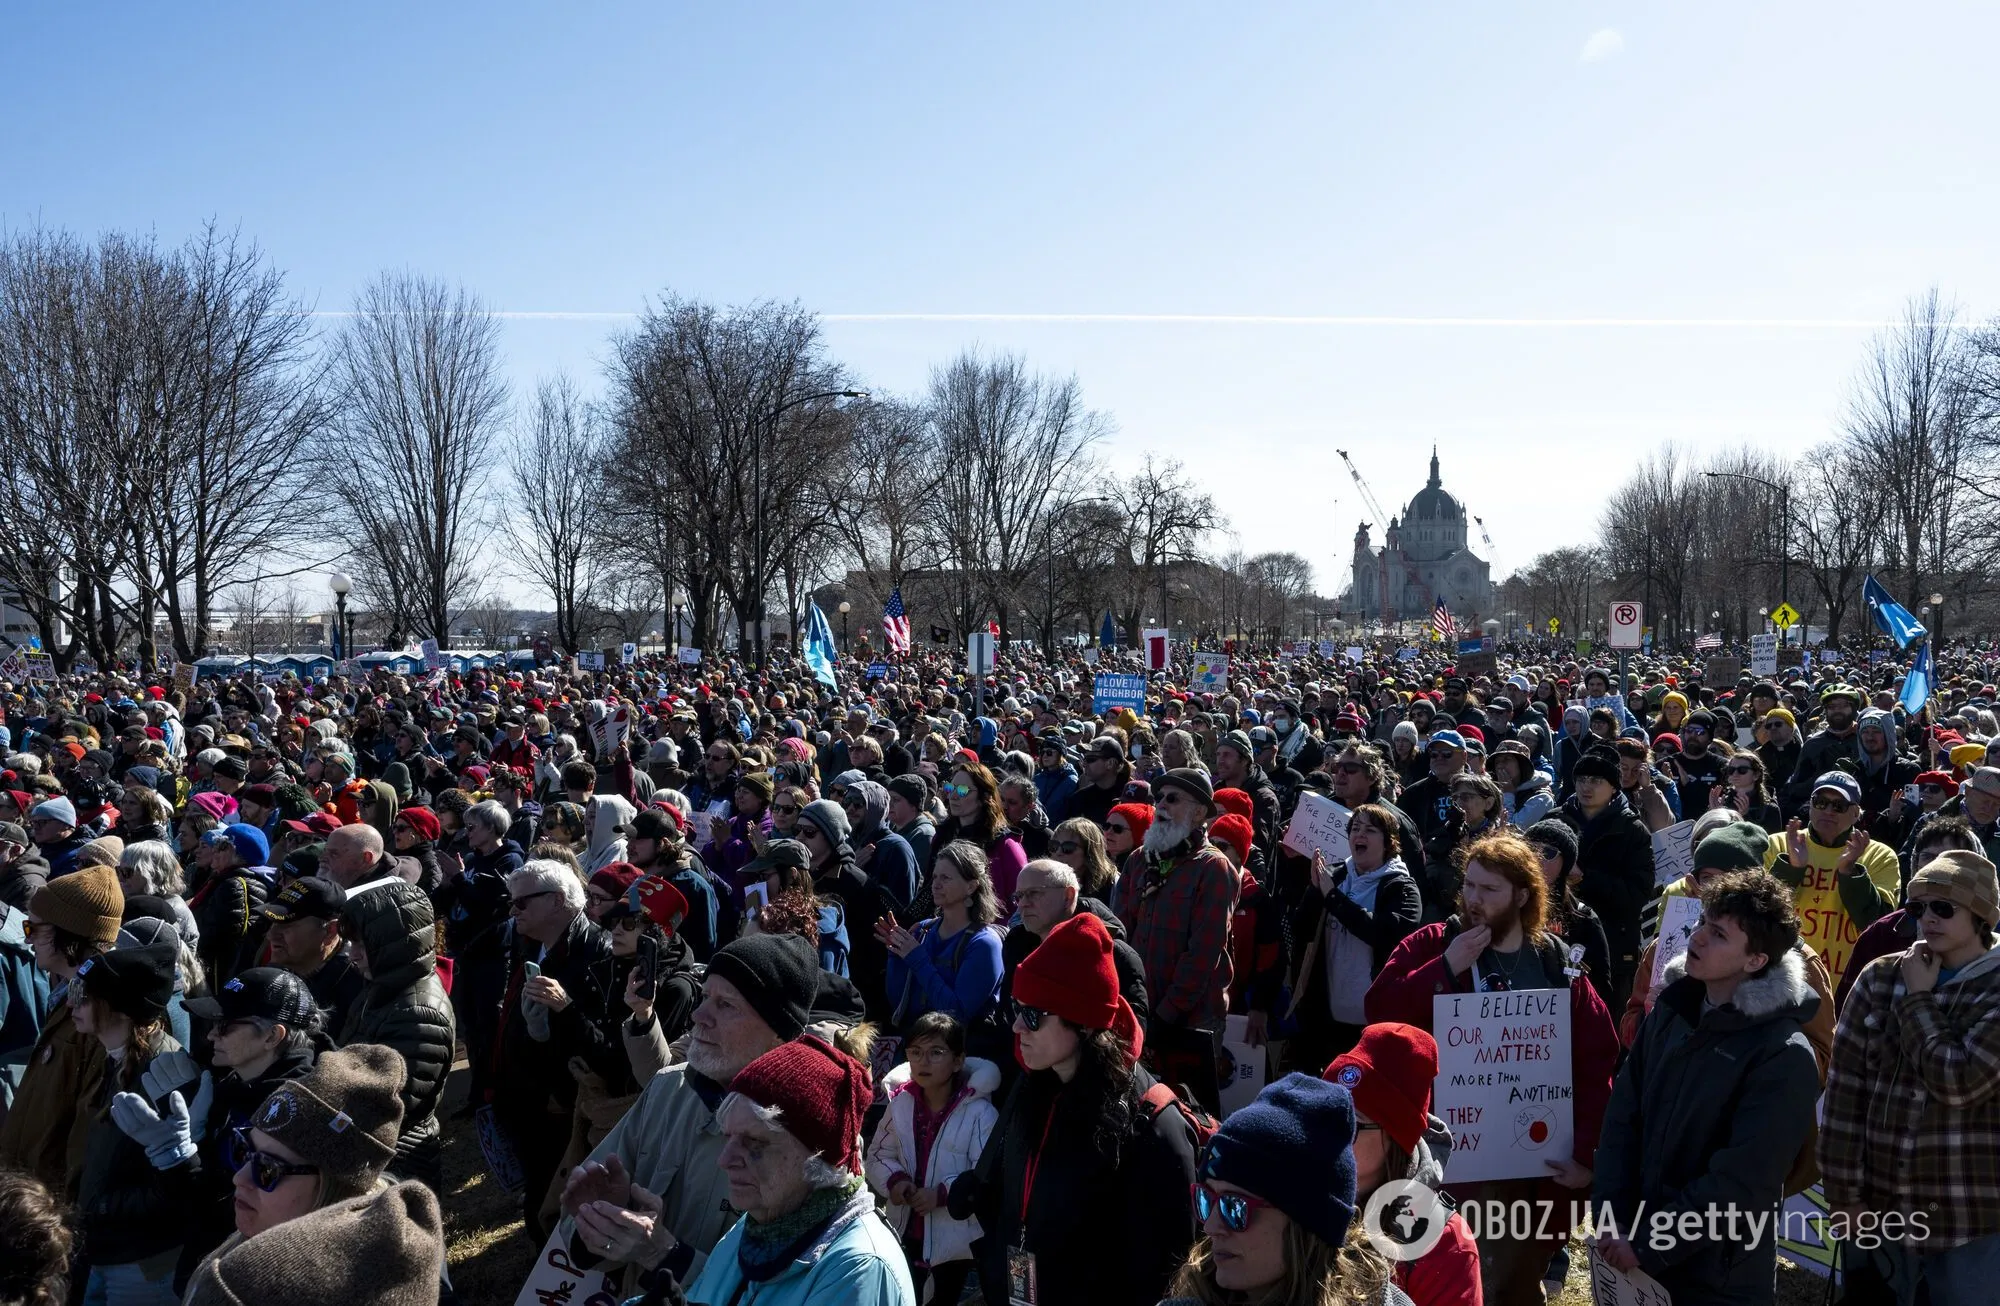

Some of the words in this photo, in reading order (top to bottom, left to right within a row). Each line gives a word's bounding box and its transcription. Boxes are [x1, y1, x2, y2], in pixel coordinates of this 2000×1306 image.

[1096, 688, 1143, 699] NEIGHBOR
[1308, 821, 1338, 844] HATES
[1453, 998, 1462, 1017] I
[1480, 994, 1557, 1018] BELIEVE
[1448, 1026, 1483, 1046] OUR
[1501, 1023, 1557, 1042] ANSWER
[1474, 1044, 1551, 1064] MATTERS
[1451, 1073, 1492, 1086] MORE
[1498, 1071, 1521, 1084] THAN
[1509, 1084, 1572, 1104] ANYTHING
[1446, 1106, 1483, 1125] THEY
